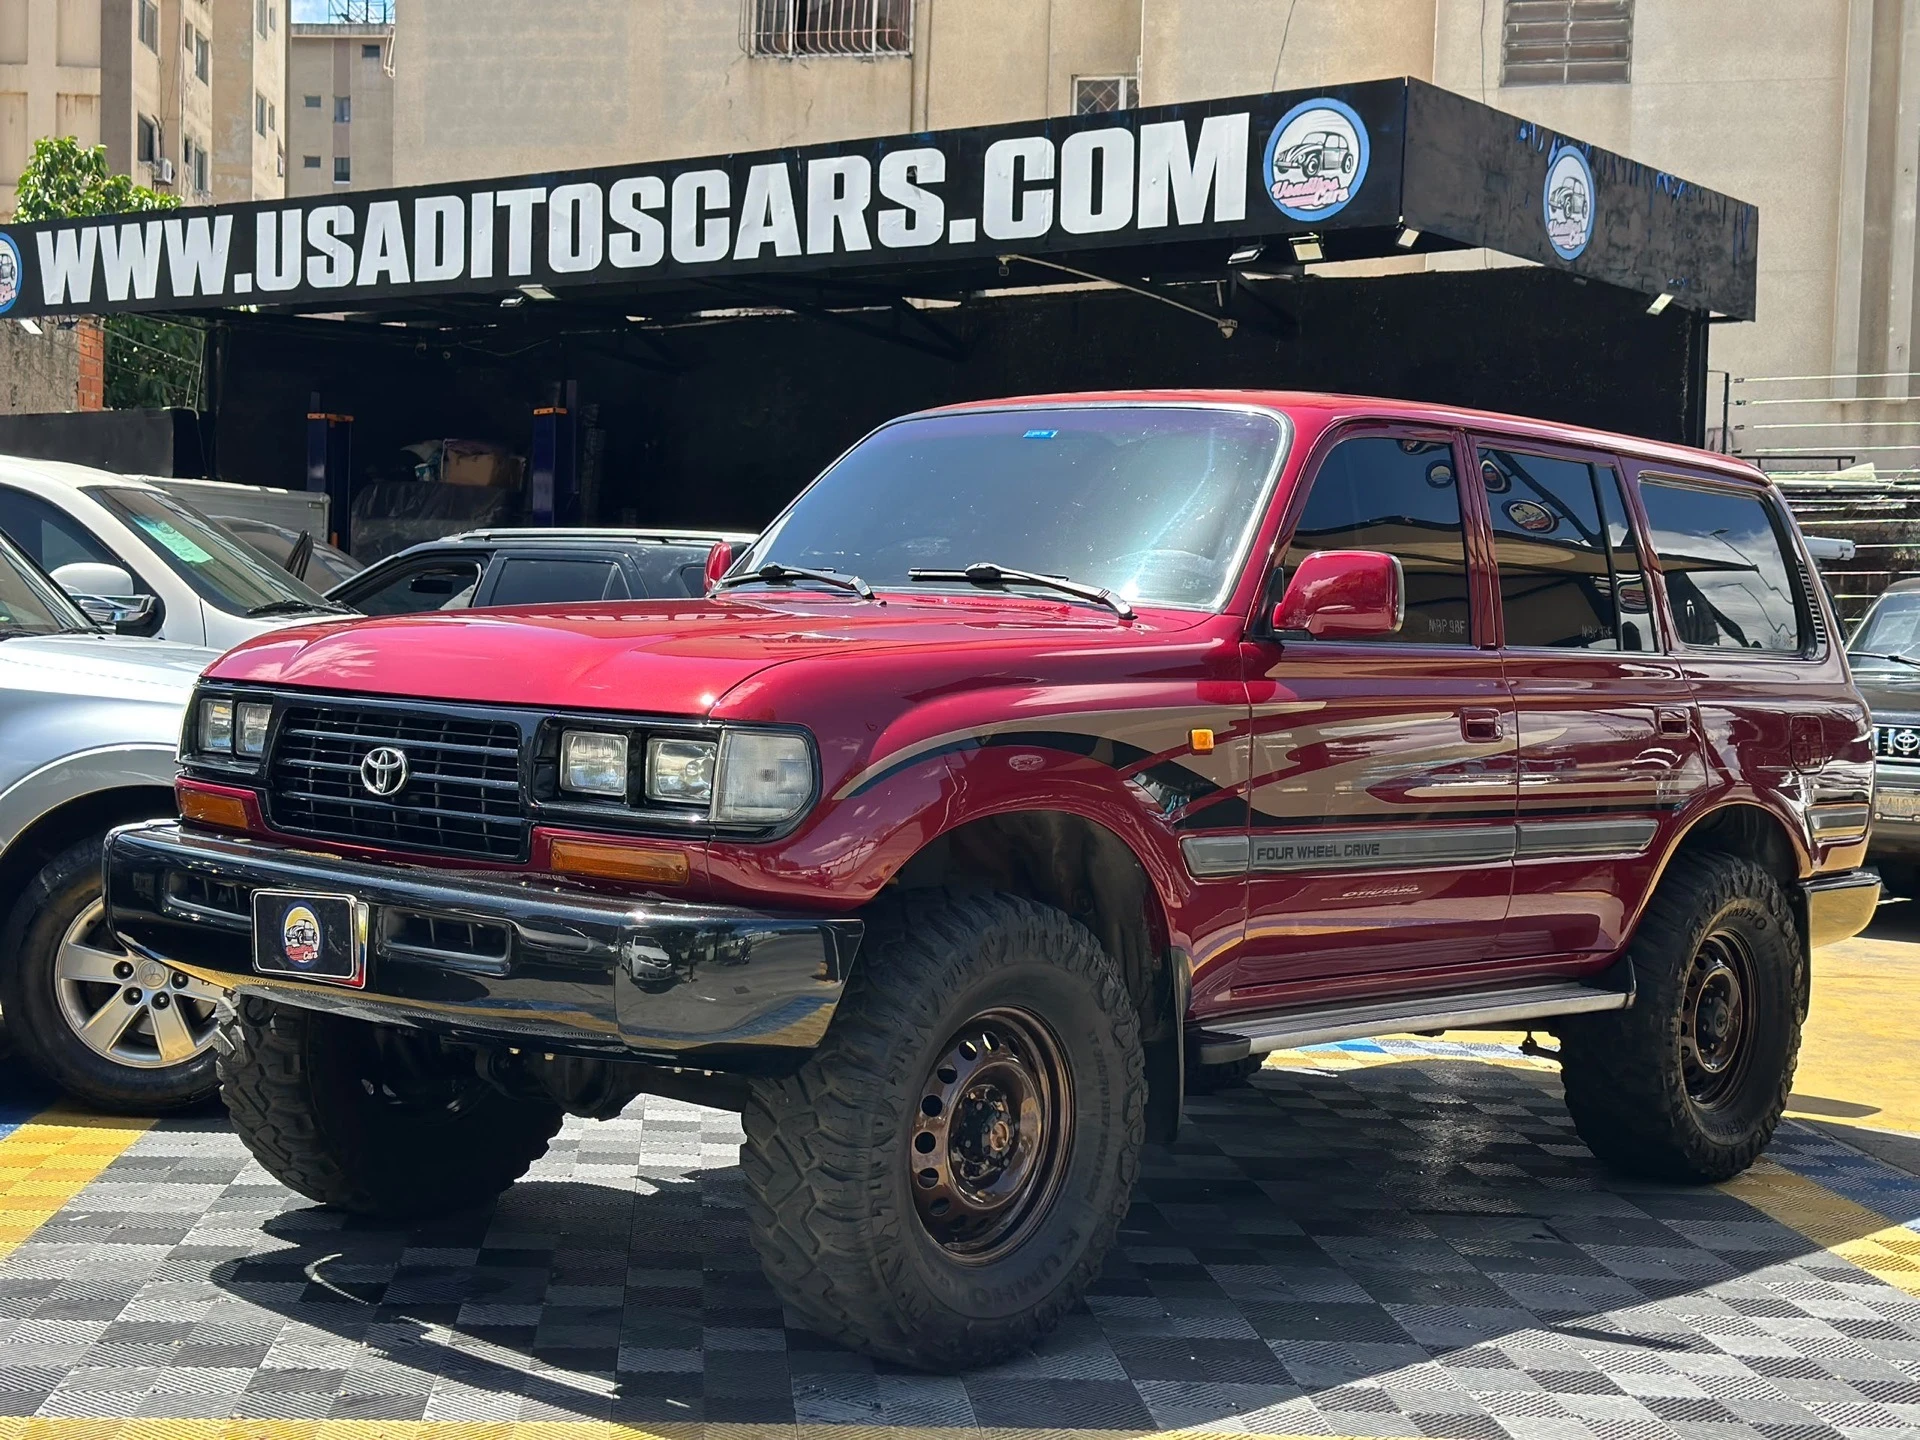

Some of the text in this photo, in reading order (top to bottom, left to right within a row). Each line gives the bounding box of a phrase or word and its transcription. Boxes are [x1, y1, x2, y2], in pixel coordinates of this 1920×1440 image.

[36, 112, 1250, 306] WWW.USADITOSCARS.COM
[1256, 843, 1380, 861] FOUR WHEEL DRIVE
